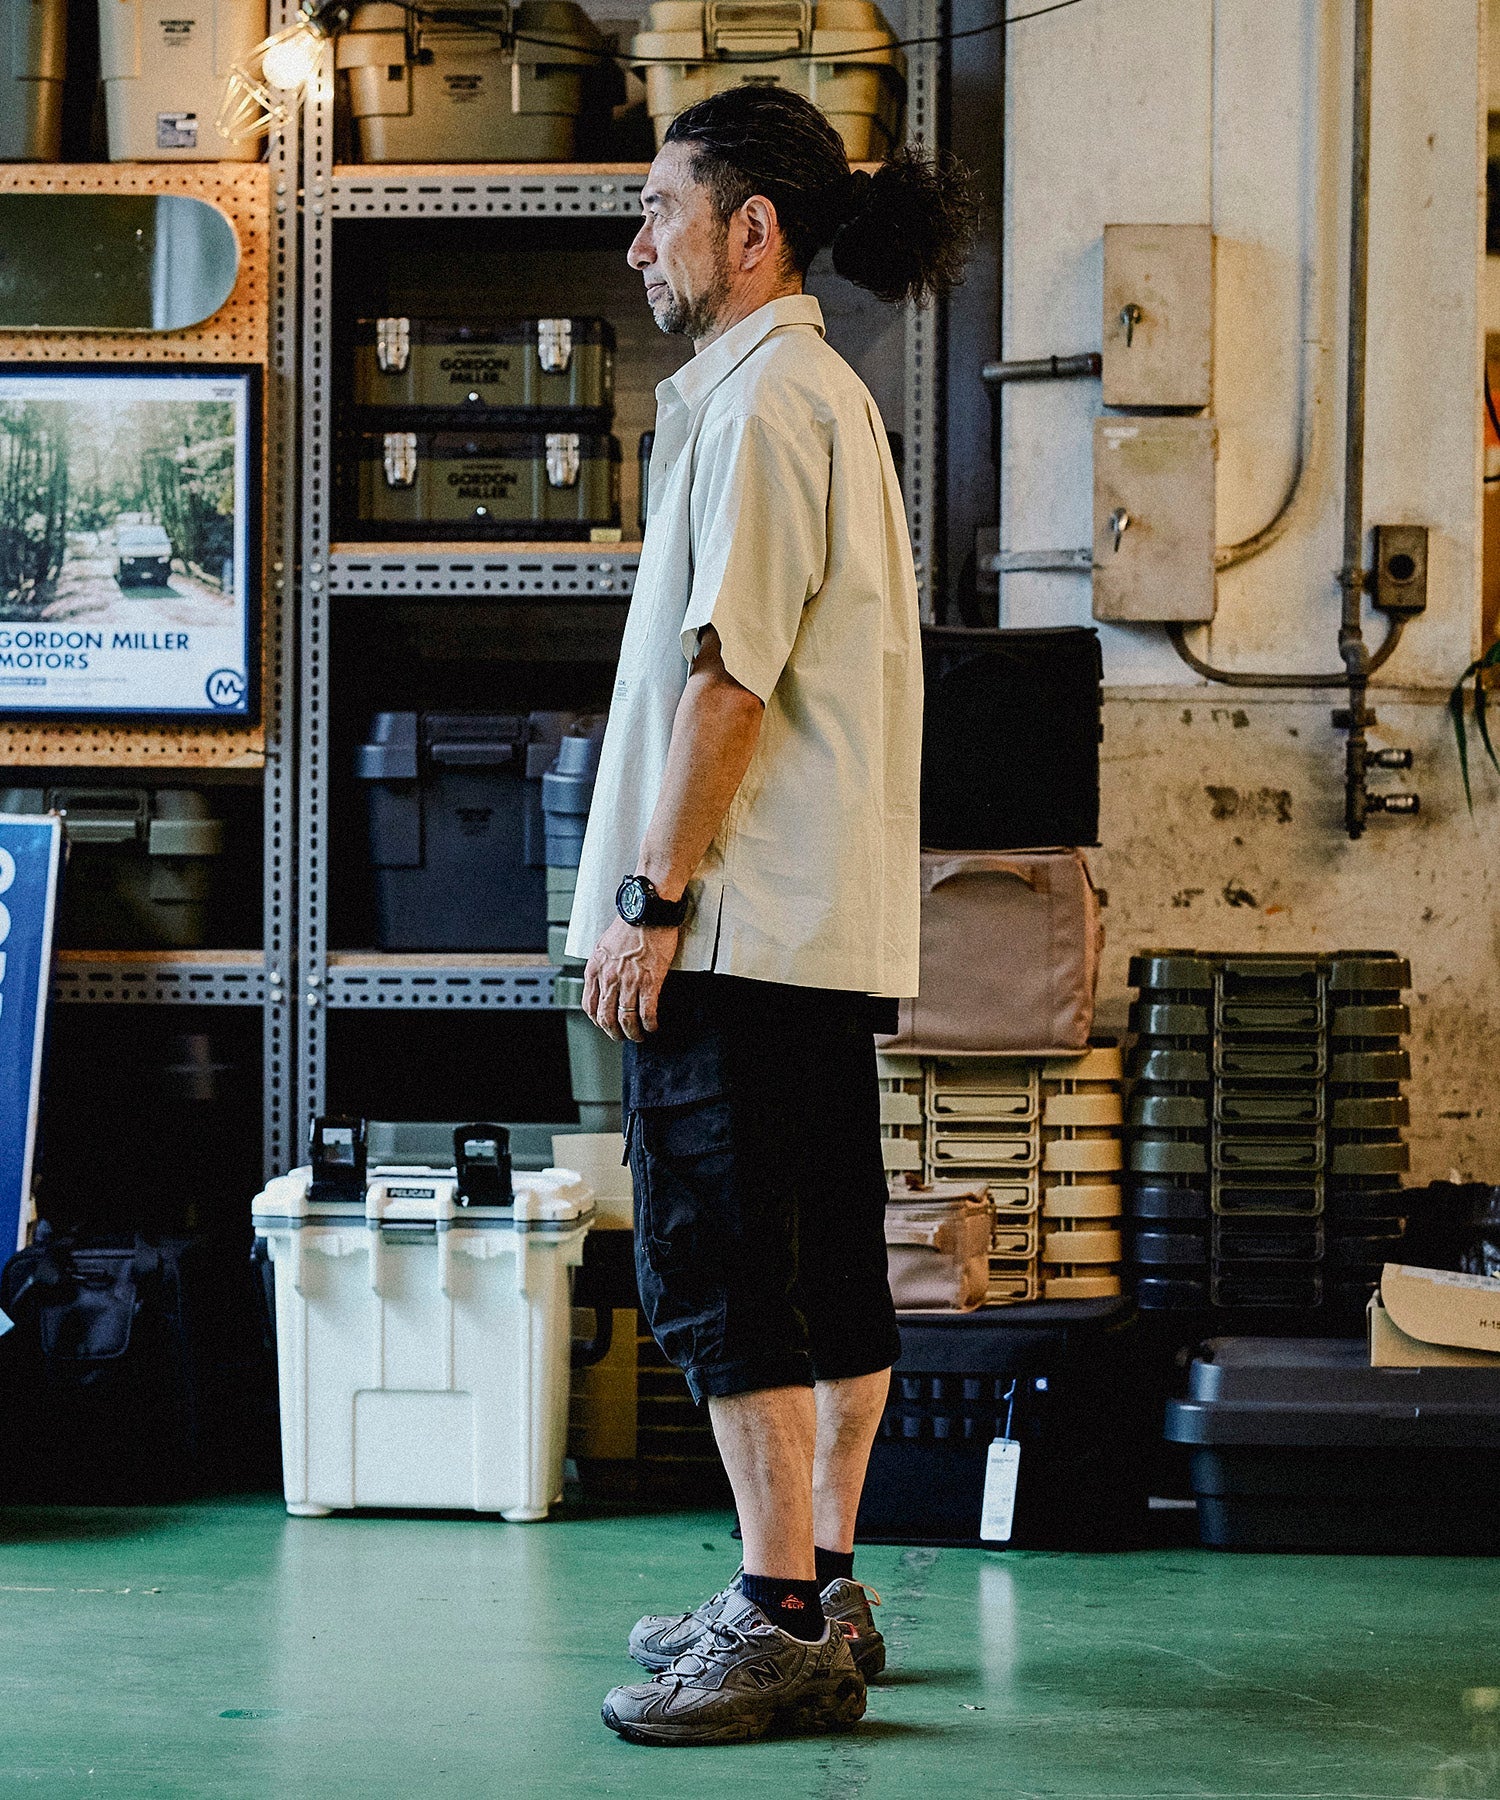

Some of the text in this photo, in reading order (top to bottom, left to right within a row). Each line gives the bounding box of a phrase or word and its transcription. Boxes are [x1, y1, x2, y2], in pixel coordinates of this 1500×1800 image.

[0, 631, 189, 650] GORDON MILLER
[0, 653, 89, 669] MOTORS
[746, 1659, 784, 1689] N
